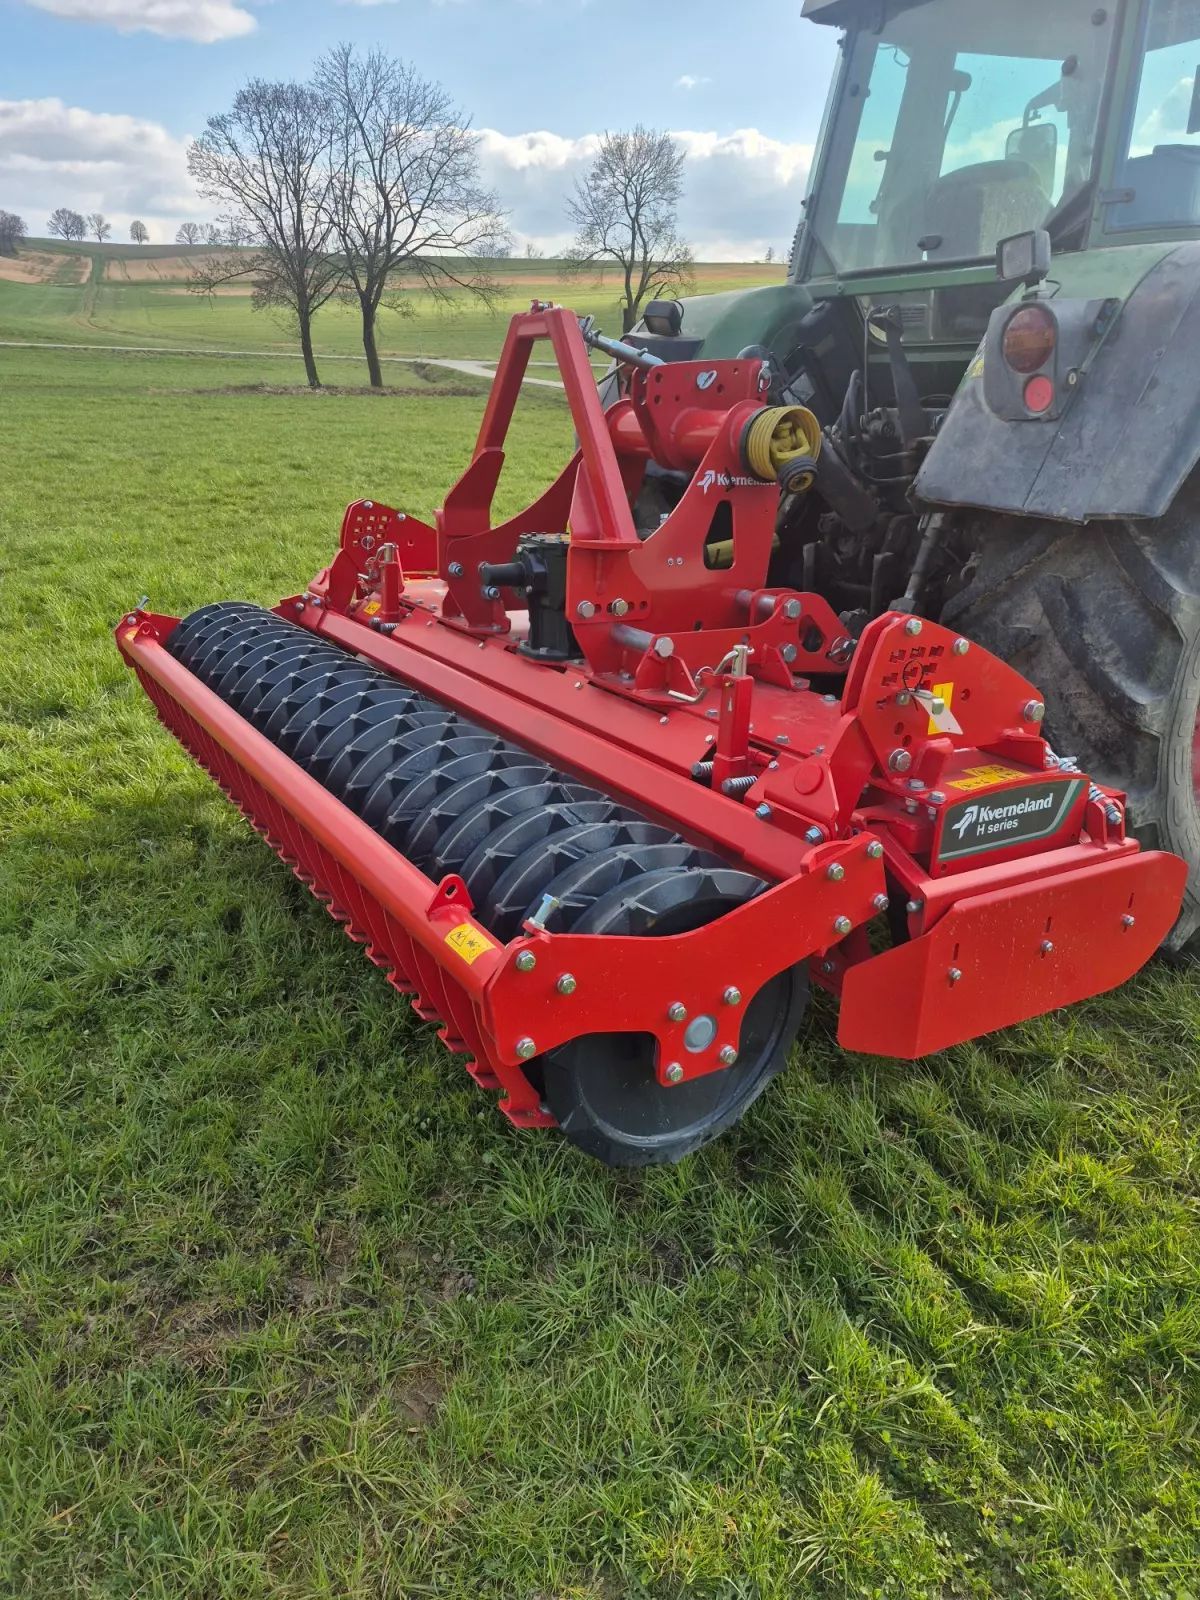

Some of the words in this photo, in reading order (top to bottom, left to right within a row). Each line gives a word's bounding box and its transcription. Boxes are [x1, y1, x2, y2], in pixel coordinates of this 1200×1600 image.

[717, 473, 776, 486] Kverne
[979, 793, 1053, 823] Kverneland
[976, 824, 986, 836] H
[987, 818, 1019, 834] series
